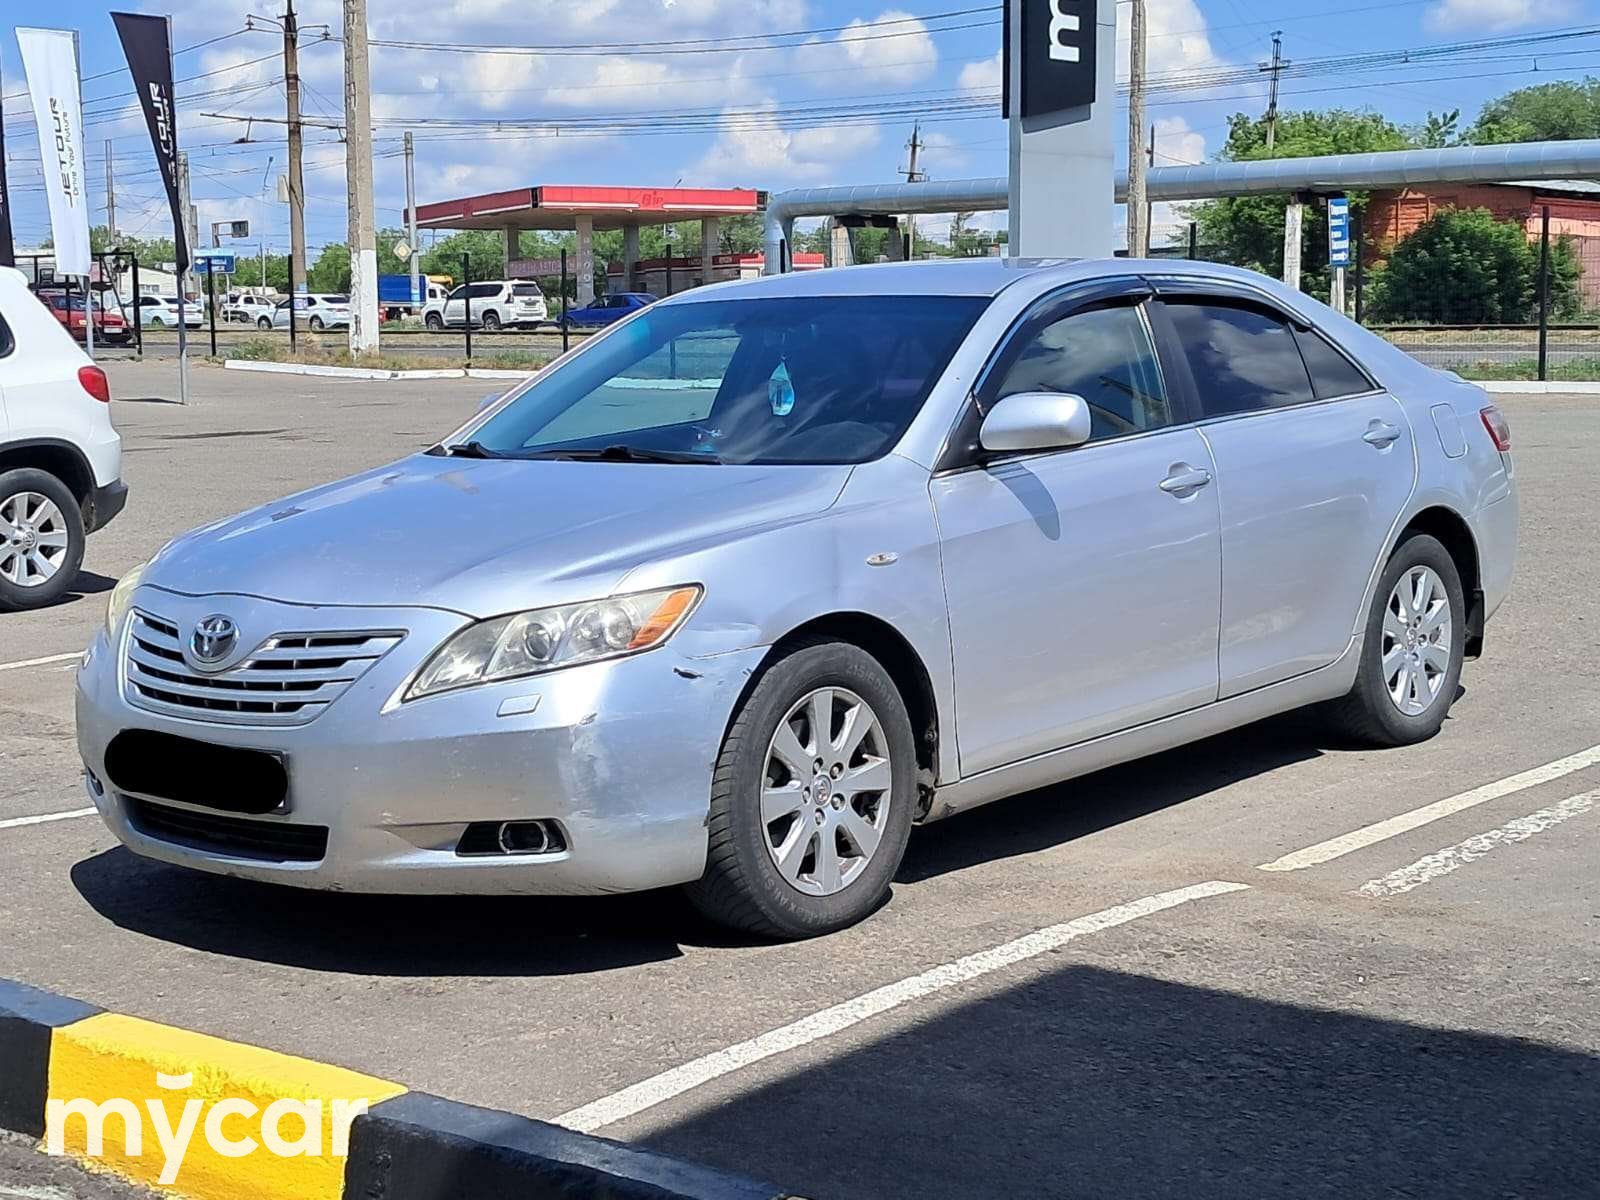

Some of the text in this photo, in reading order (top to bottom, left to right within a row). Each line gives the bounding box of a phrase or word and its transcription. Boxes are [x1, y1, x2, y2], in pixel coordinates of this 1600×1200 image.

[63, 112, 71, 143] Future
[50, 97, 74, 208] JETOUR
[71, 171, 79, 196] Drive
